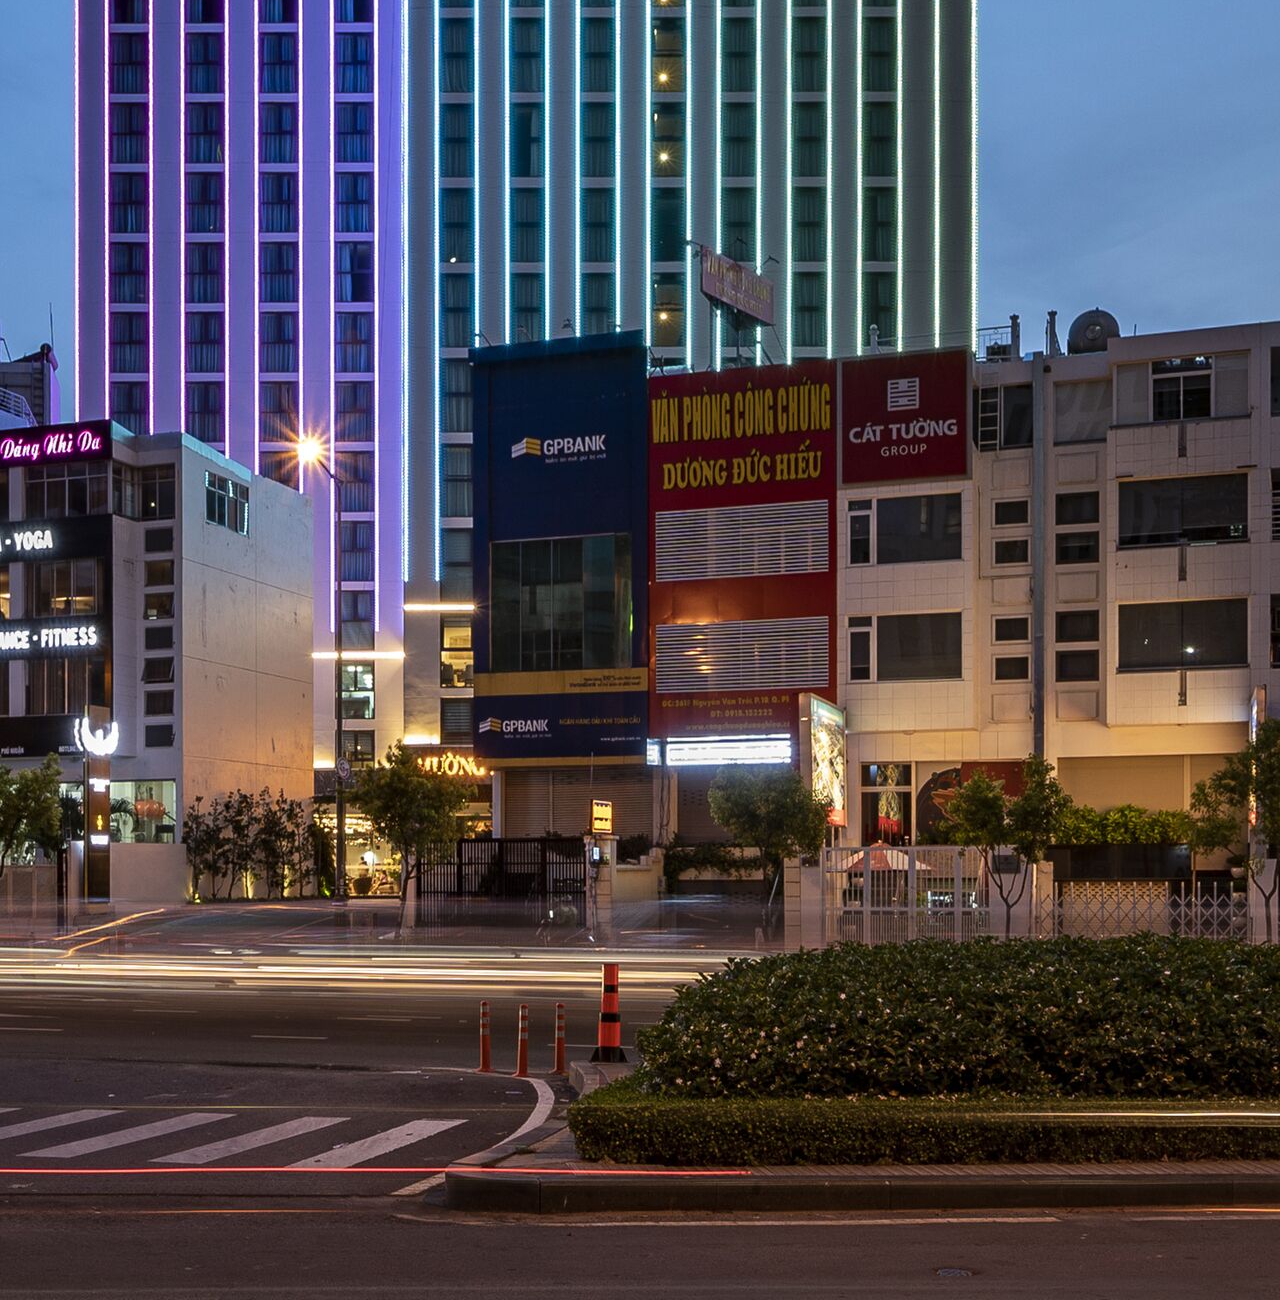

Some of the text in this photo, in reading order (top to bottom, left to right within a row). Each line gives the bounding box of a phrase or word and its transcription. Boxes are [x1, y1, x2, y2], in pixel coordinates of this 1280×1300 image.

[652, 377, 831, 444] VĂN PHÒNG CÔNG CHỨNG
[848, 418, 958, 444] CÁT TƯỜNG
[0, 438, 40, 461] Dáng
[543, 434, 606, 455] GPBANK
[880, 443, 927, 457] GROUP
[663, 439, 822, 490] DƯƠNG ĐỨC HIẾU
[14, 530, 53, 551] YOGA
[40, 626, 98, 648] FITNESS
[502, 719, 549, 733] GPBANK
